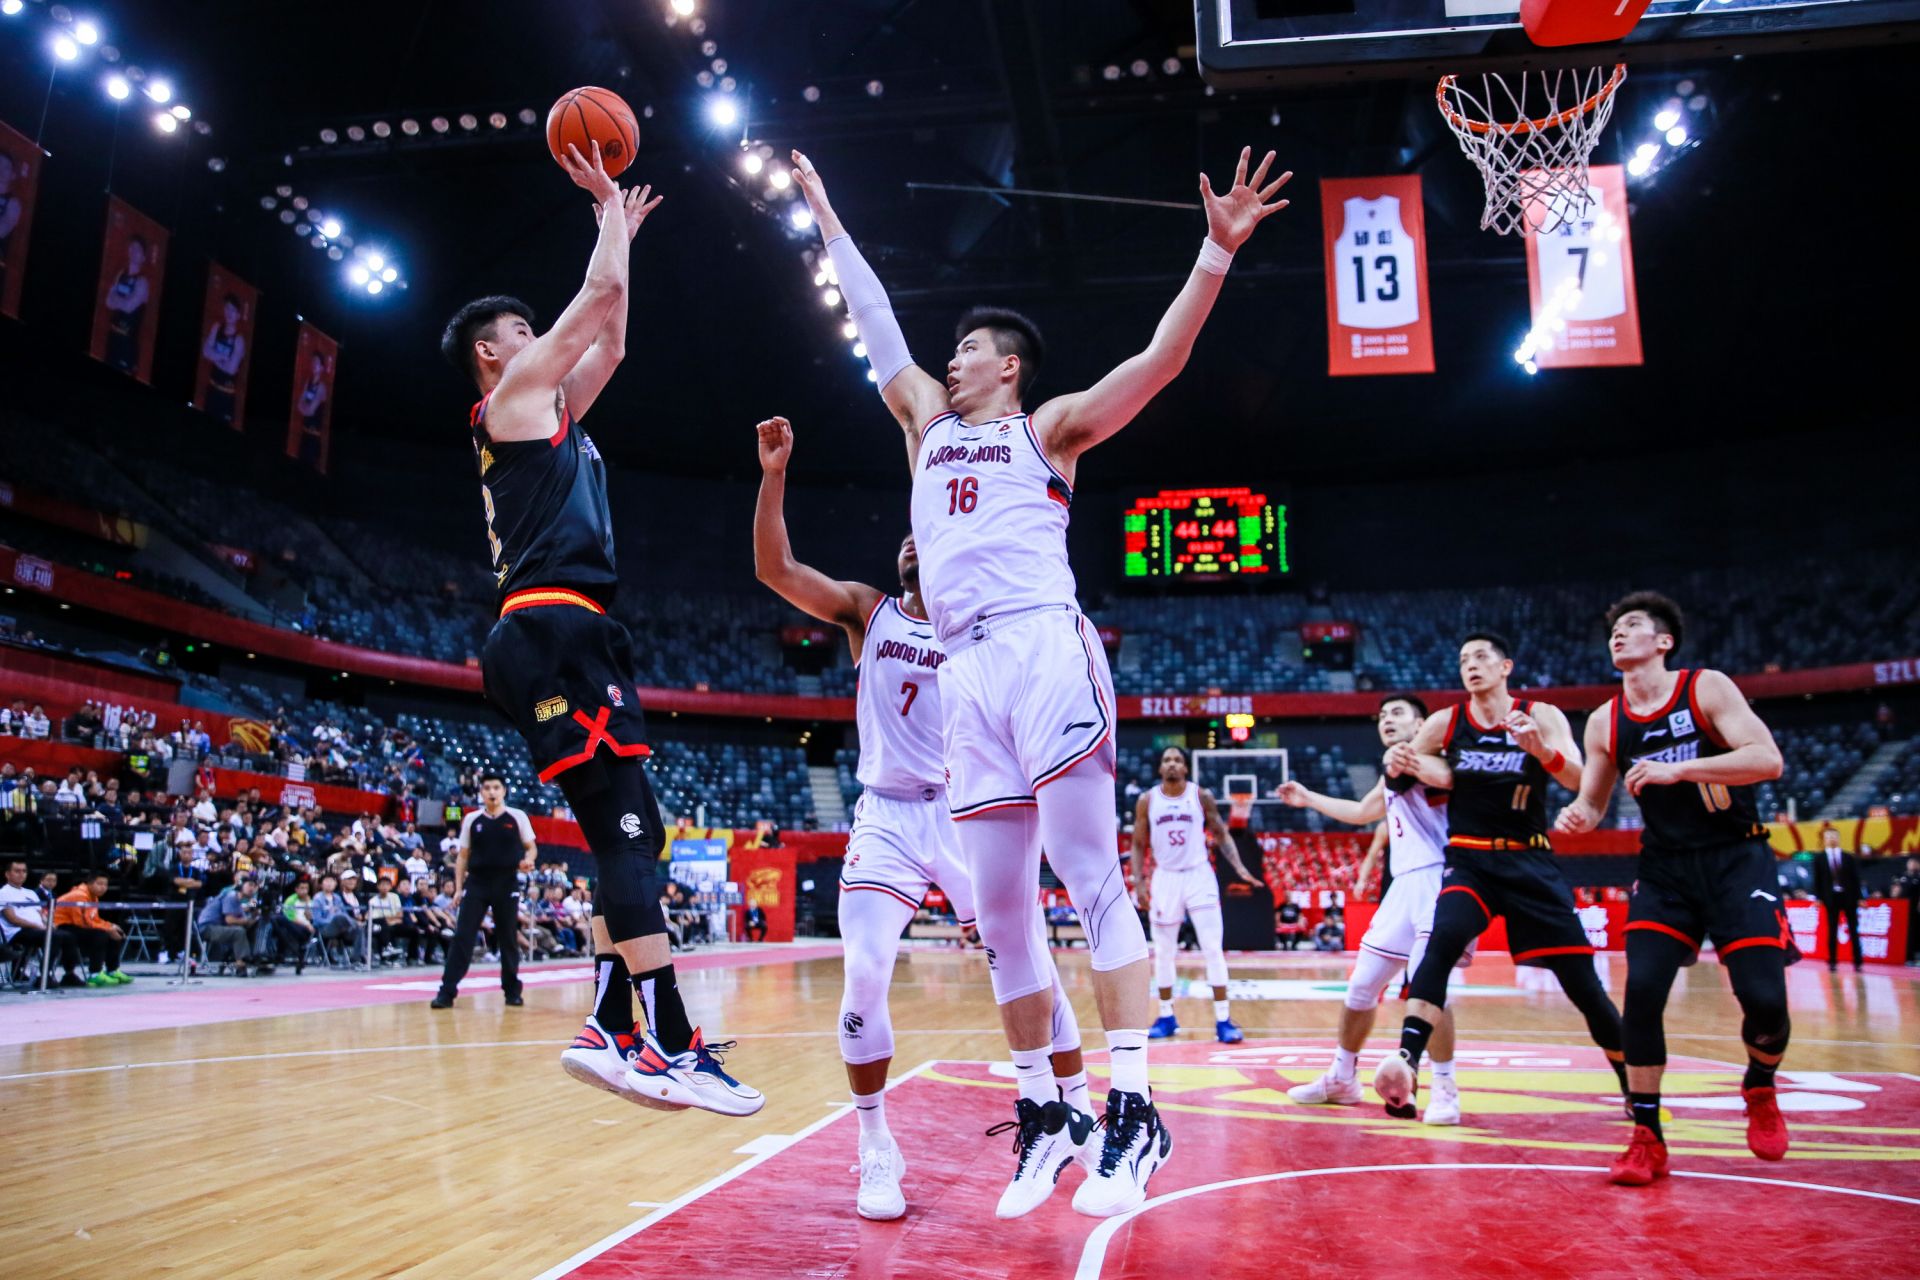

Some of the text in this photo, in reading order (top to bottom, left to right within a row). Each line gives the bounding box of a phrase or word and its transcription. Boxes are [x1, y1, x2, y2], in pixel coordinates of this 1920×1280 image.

[1353, 255, 1399, 303] 13
[1568, 247, 1589, 292] 7
[967, 445, 1011, 464] LIONS
[946, 476, 979, 516] 16
[1174, 519, 1237, 539] 44 44
[877, 640, 917, 664] LOONG
[901, 682, 919, 716] 7
[1511, 784, 1531, 811] 11
[1168, 829, 1186, 846] 55
